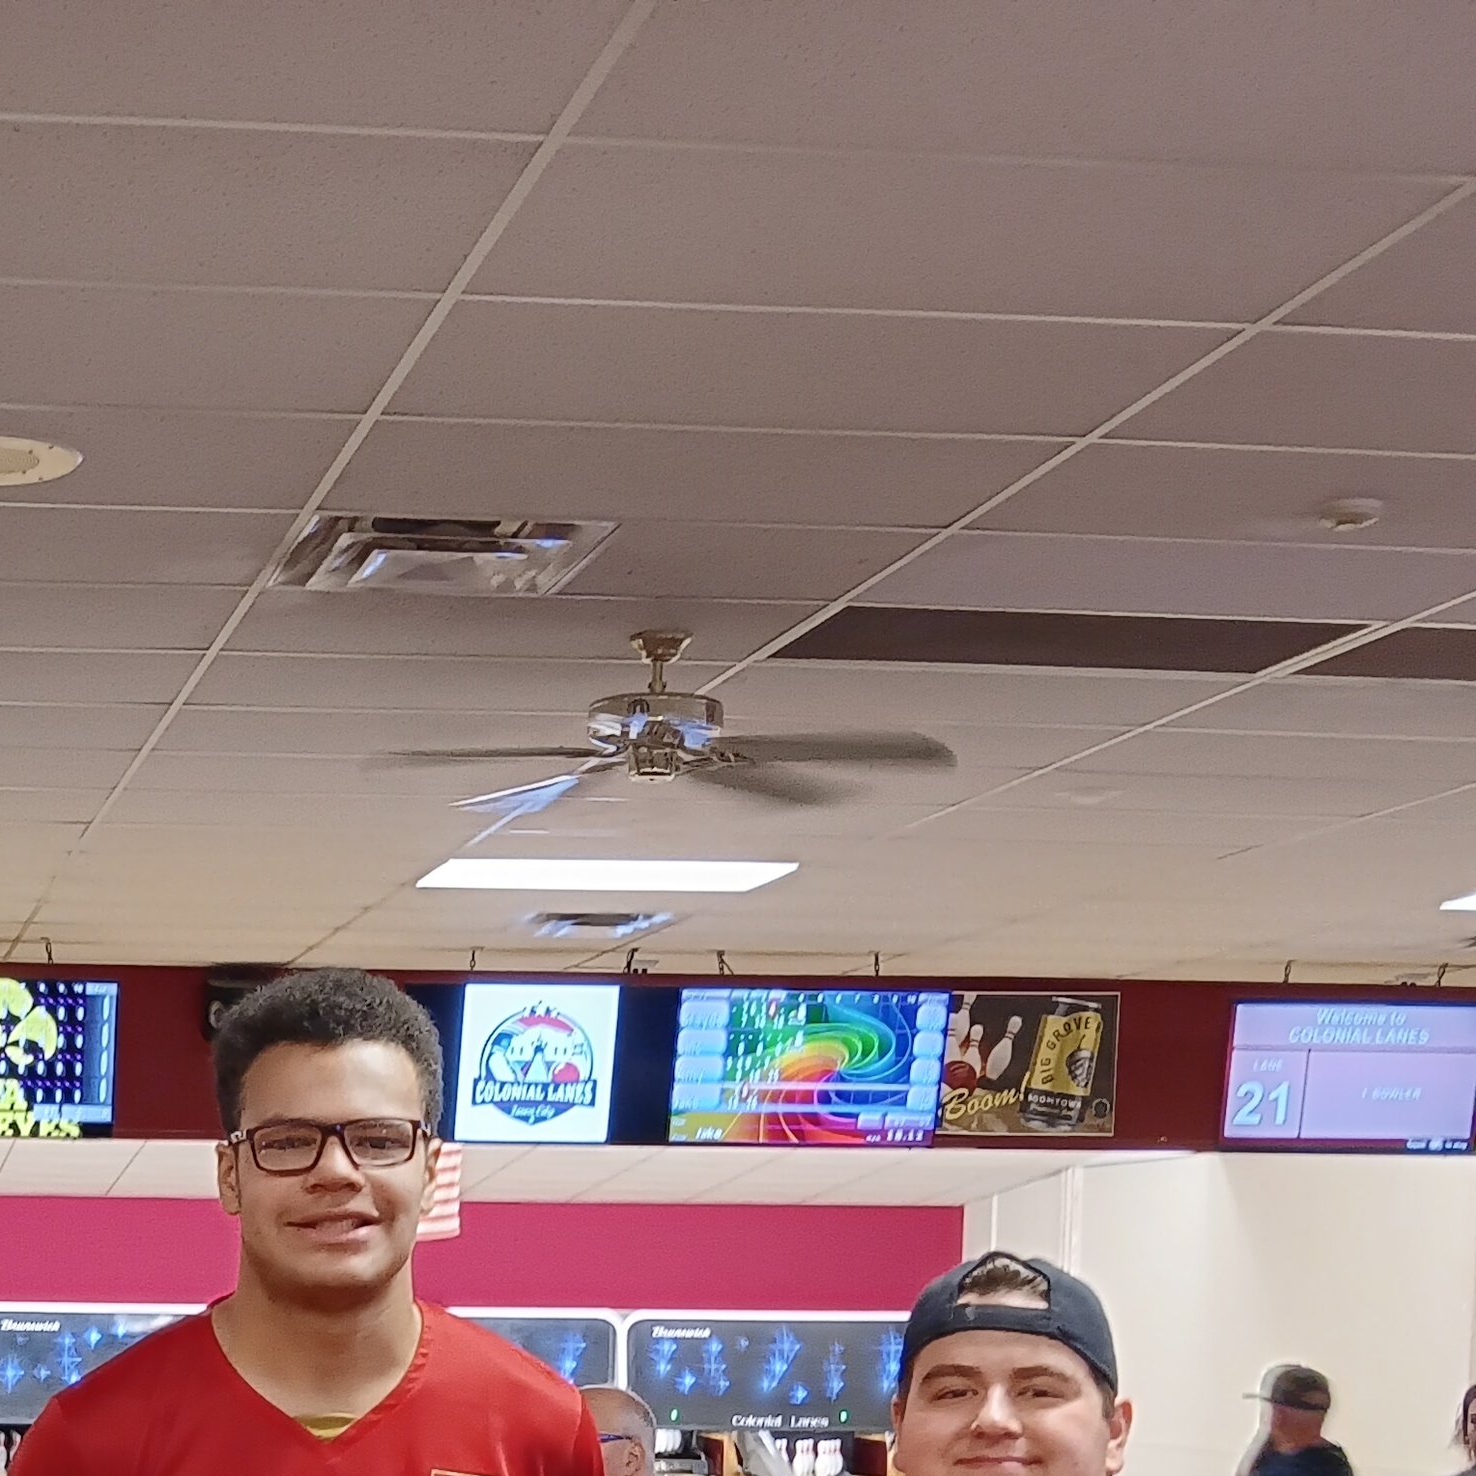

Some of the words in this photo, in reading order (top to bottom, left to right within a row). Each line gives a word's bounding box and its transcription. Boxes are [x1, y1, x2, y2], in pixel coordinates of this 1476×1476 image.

[1316, 1007, 1385, 1025] Welcome
[1389, 1009, 1406, 1026] to
[1047, 1015, 1092, 1051] GROVE
[1288, 1026, 1372, 1044] COLONIAL
[1375, 1027, 1430, 1045] LANES
[475, 1080, 545, 1103] COLONIAL
[547, 1080, 593, 1105] LANES
[942, 1071, 1031, 1120] Boom!
[1232, 1080, 1291, 1126] 21
[731, 1414, 782, 1428] Colonial
[790, 1415, 829, 1428] Lanes
